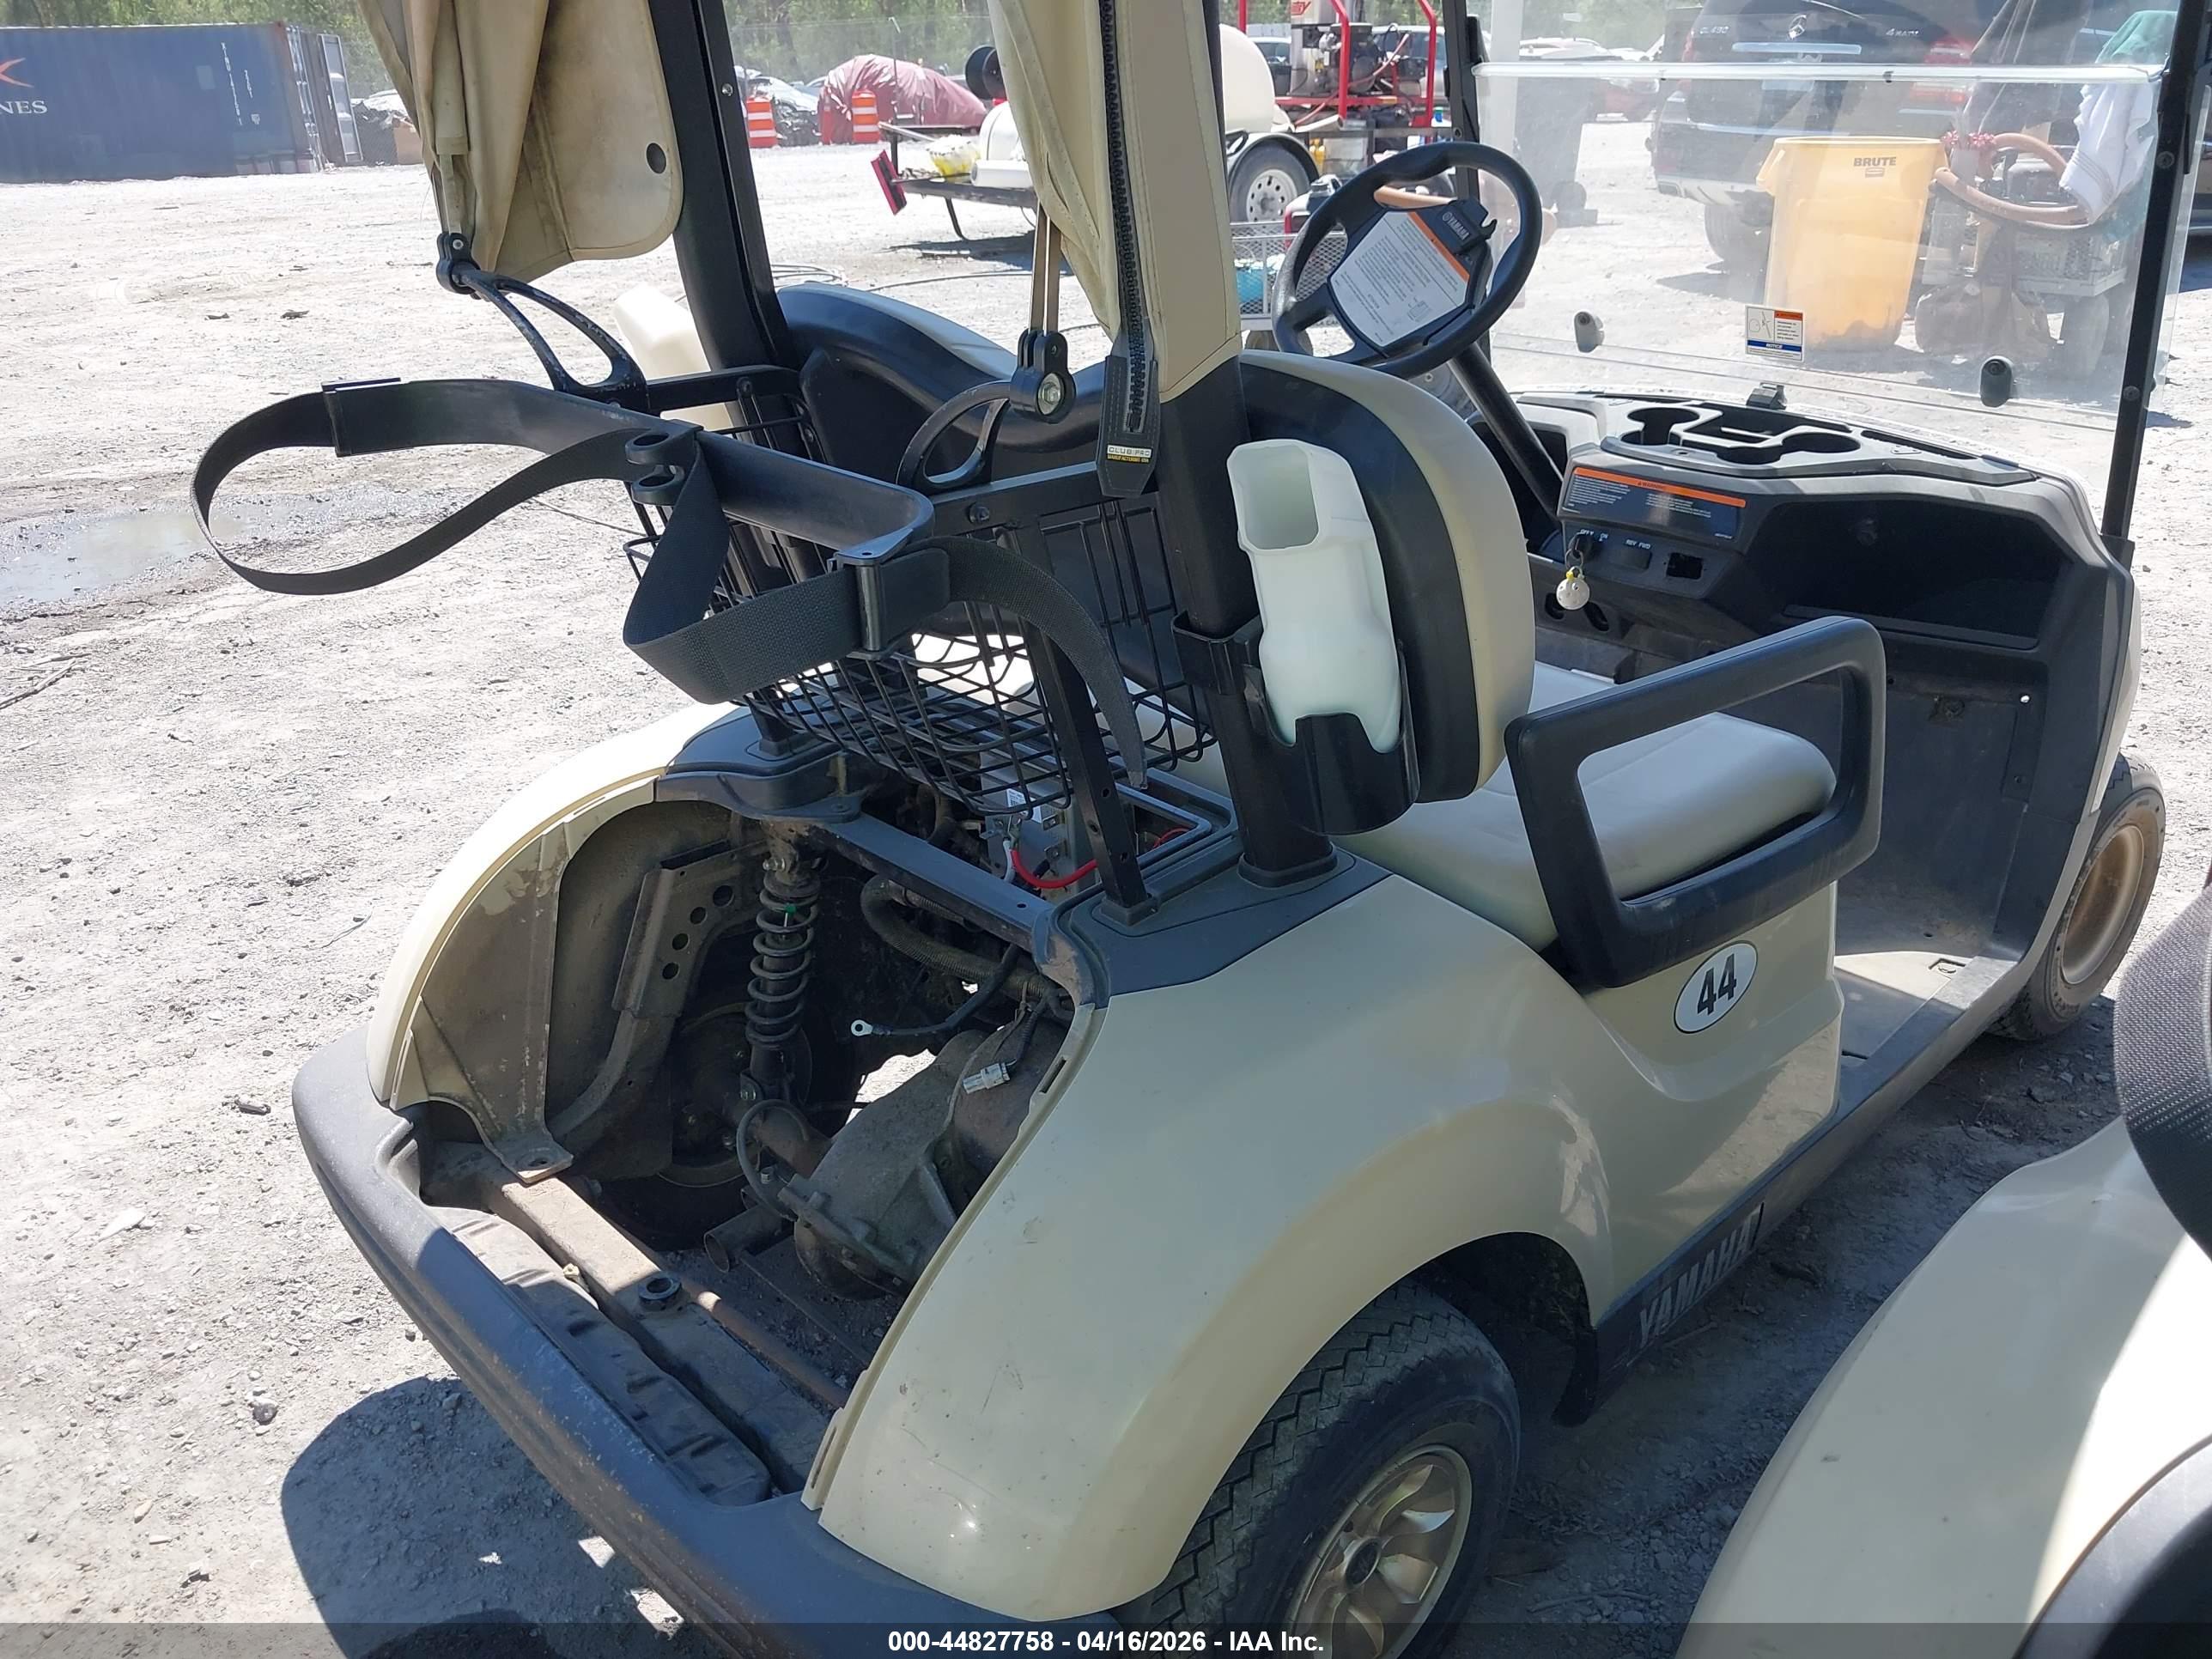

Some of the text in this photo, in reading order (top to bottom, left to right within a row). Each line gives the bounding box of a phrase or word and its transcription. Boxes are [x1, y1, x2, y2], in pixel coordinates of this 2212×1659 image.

[1853, 156, 1897, 167] BRUTE
[1447, 216, 1469, 240] YAMAHA
[1697, 953, 1737, 1015] 44
[1639, 1213, 1753, 1348] YAMAHA
